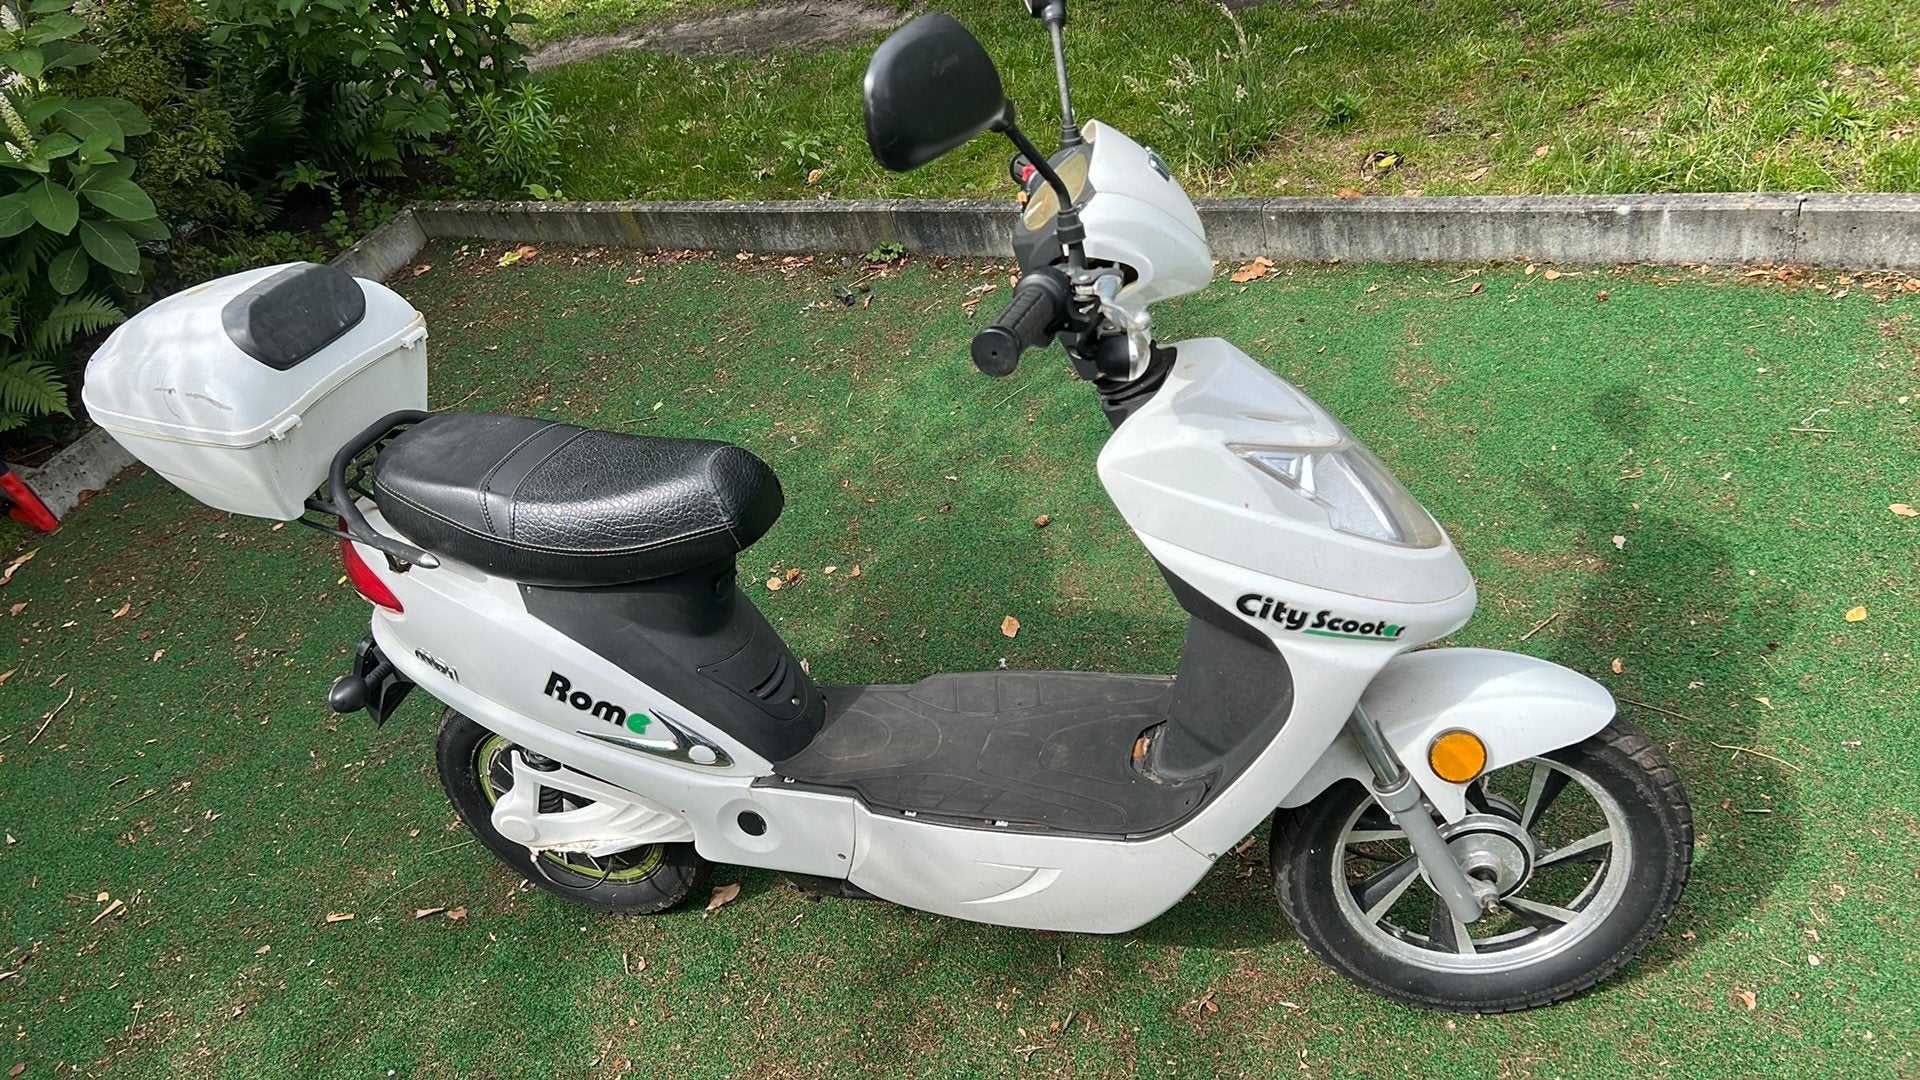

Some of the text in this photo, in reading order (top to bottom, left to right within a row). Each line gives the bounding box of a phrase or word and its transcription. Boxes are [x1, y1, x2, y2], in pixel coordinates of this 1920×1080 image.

[1236, 593, 1406, 637] City Scooter
[544, 671, 652, 735] Rome
